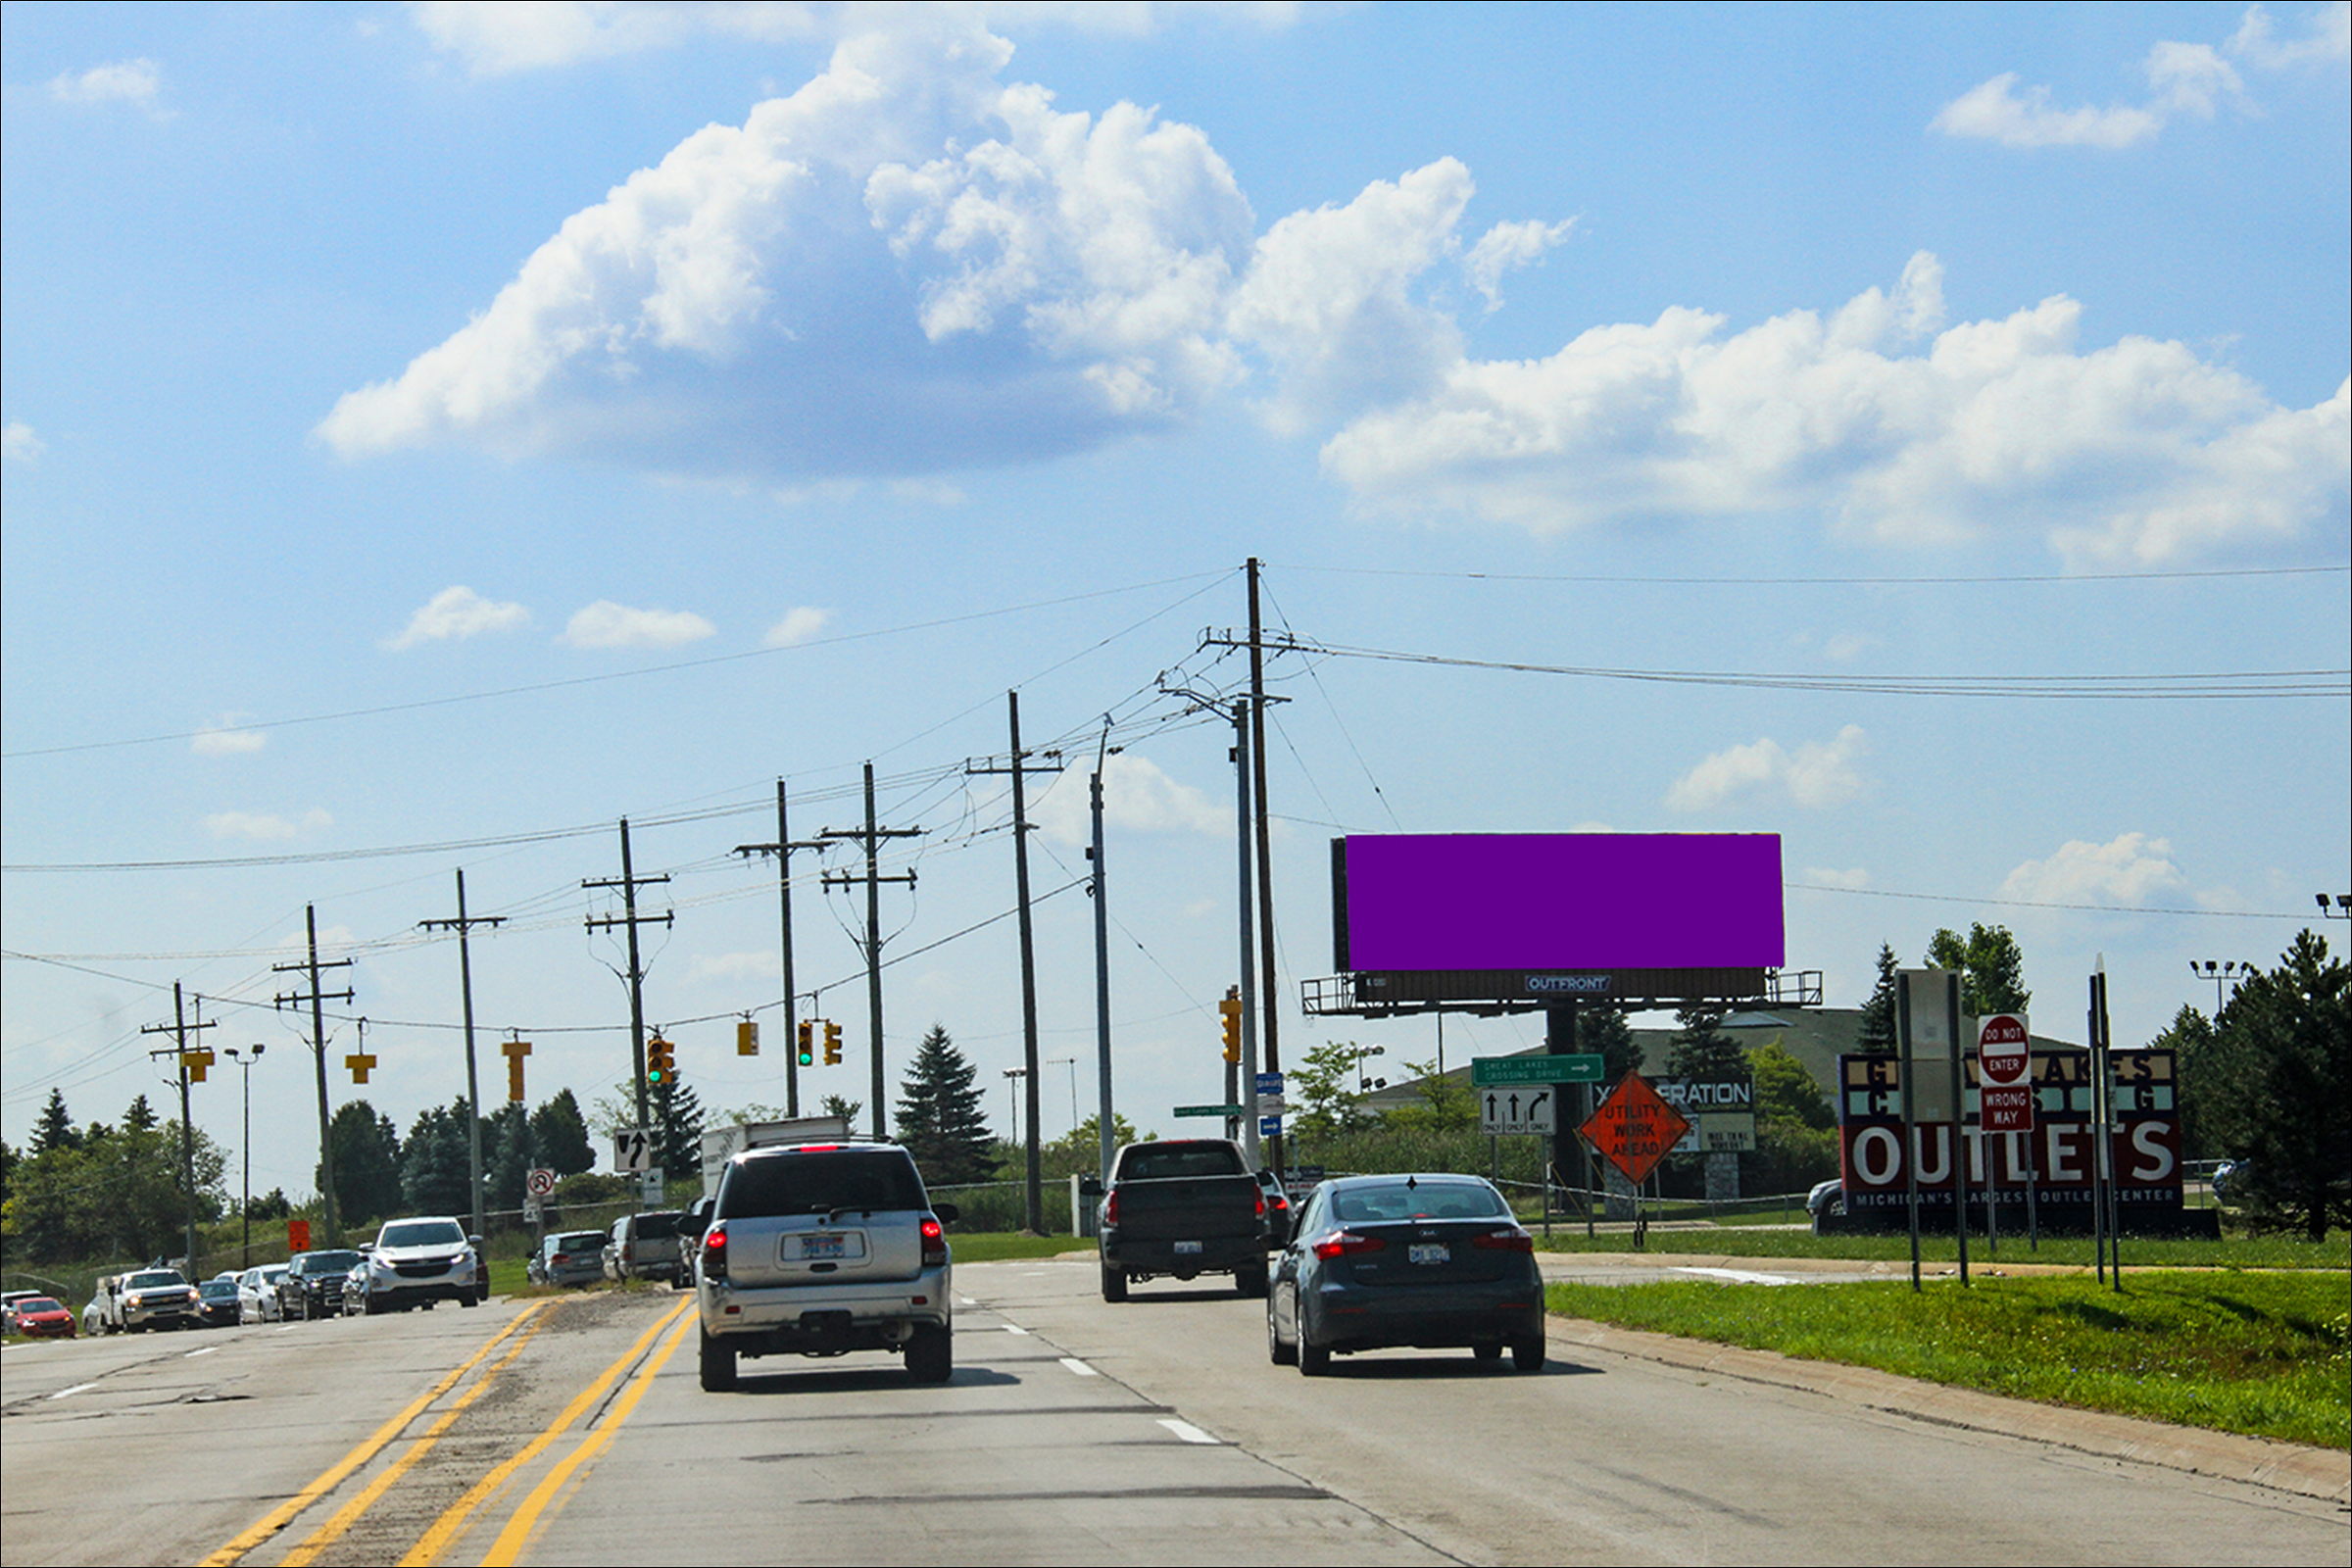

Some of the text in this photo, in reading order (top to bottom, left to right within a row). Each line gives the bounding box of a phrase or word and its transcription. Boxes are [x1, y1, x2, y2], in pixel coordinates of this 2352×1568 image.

[1528, 976, 1607, 990] OUTFRONT
[1984, 1027, 2022, 1041] DO NOT
[1483, 1060, 1549, 1071] GREAT LAKES
[1988, 1058, 2021, 1072] ENTER
[2032, 1054, 2154, 1082] AKES
[1485, 1068, 1563, 1080] CROSSING DRIVE
[1594, 1082, 1751, 1107] XERATION
[1984, 1092, 2028, 1107] WRONG
[1604, 1103, 1661, 1120] UTILITY
[1992, 1109, 2019, 1125] WAY
[1483, 1123, 1501, 1132] ONLY
[1506, 1123, 1525, 1132] ONLY
[1530, 1122, 1549, 1131] ONLY
[1613, 1122, 1656, 1139] WORK
[1611, 1141, 1660, 1157] AHEAD
[1852, 1120, 2175, 1186] OUTLETS
[2039, 1189, 2093, 1203] OUTLE
